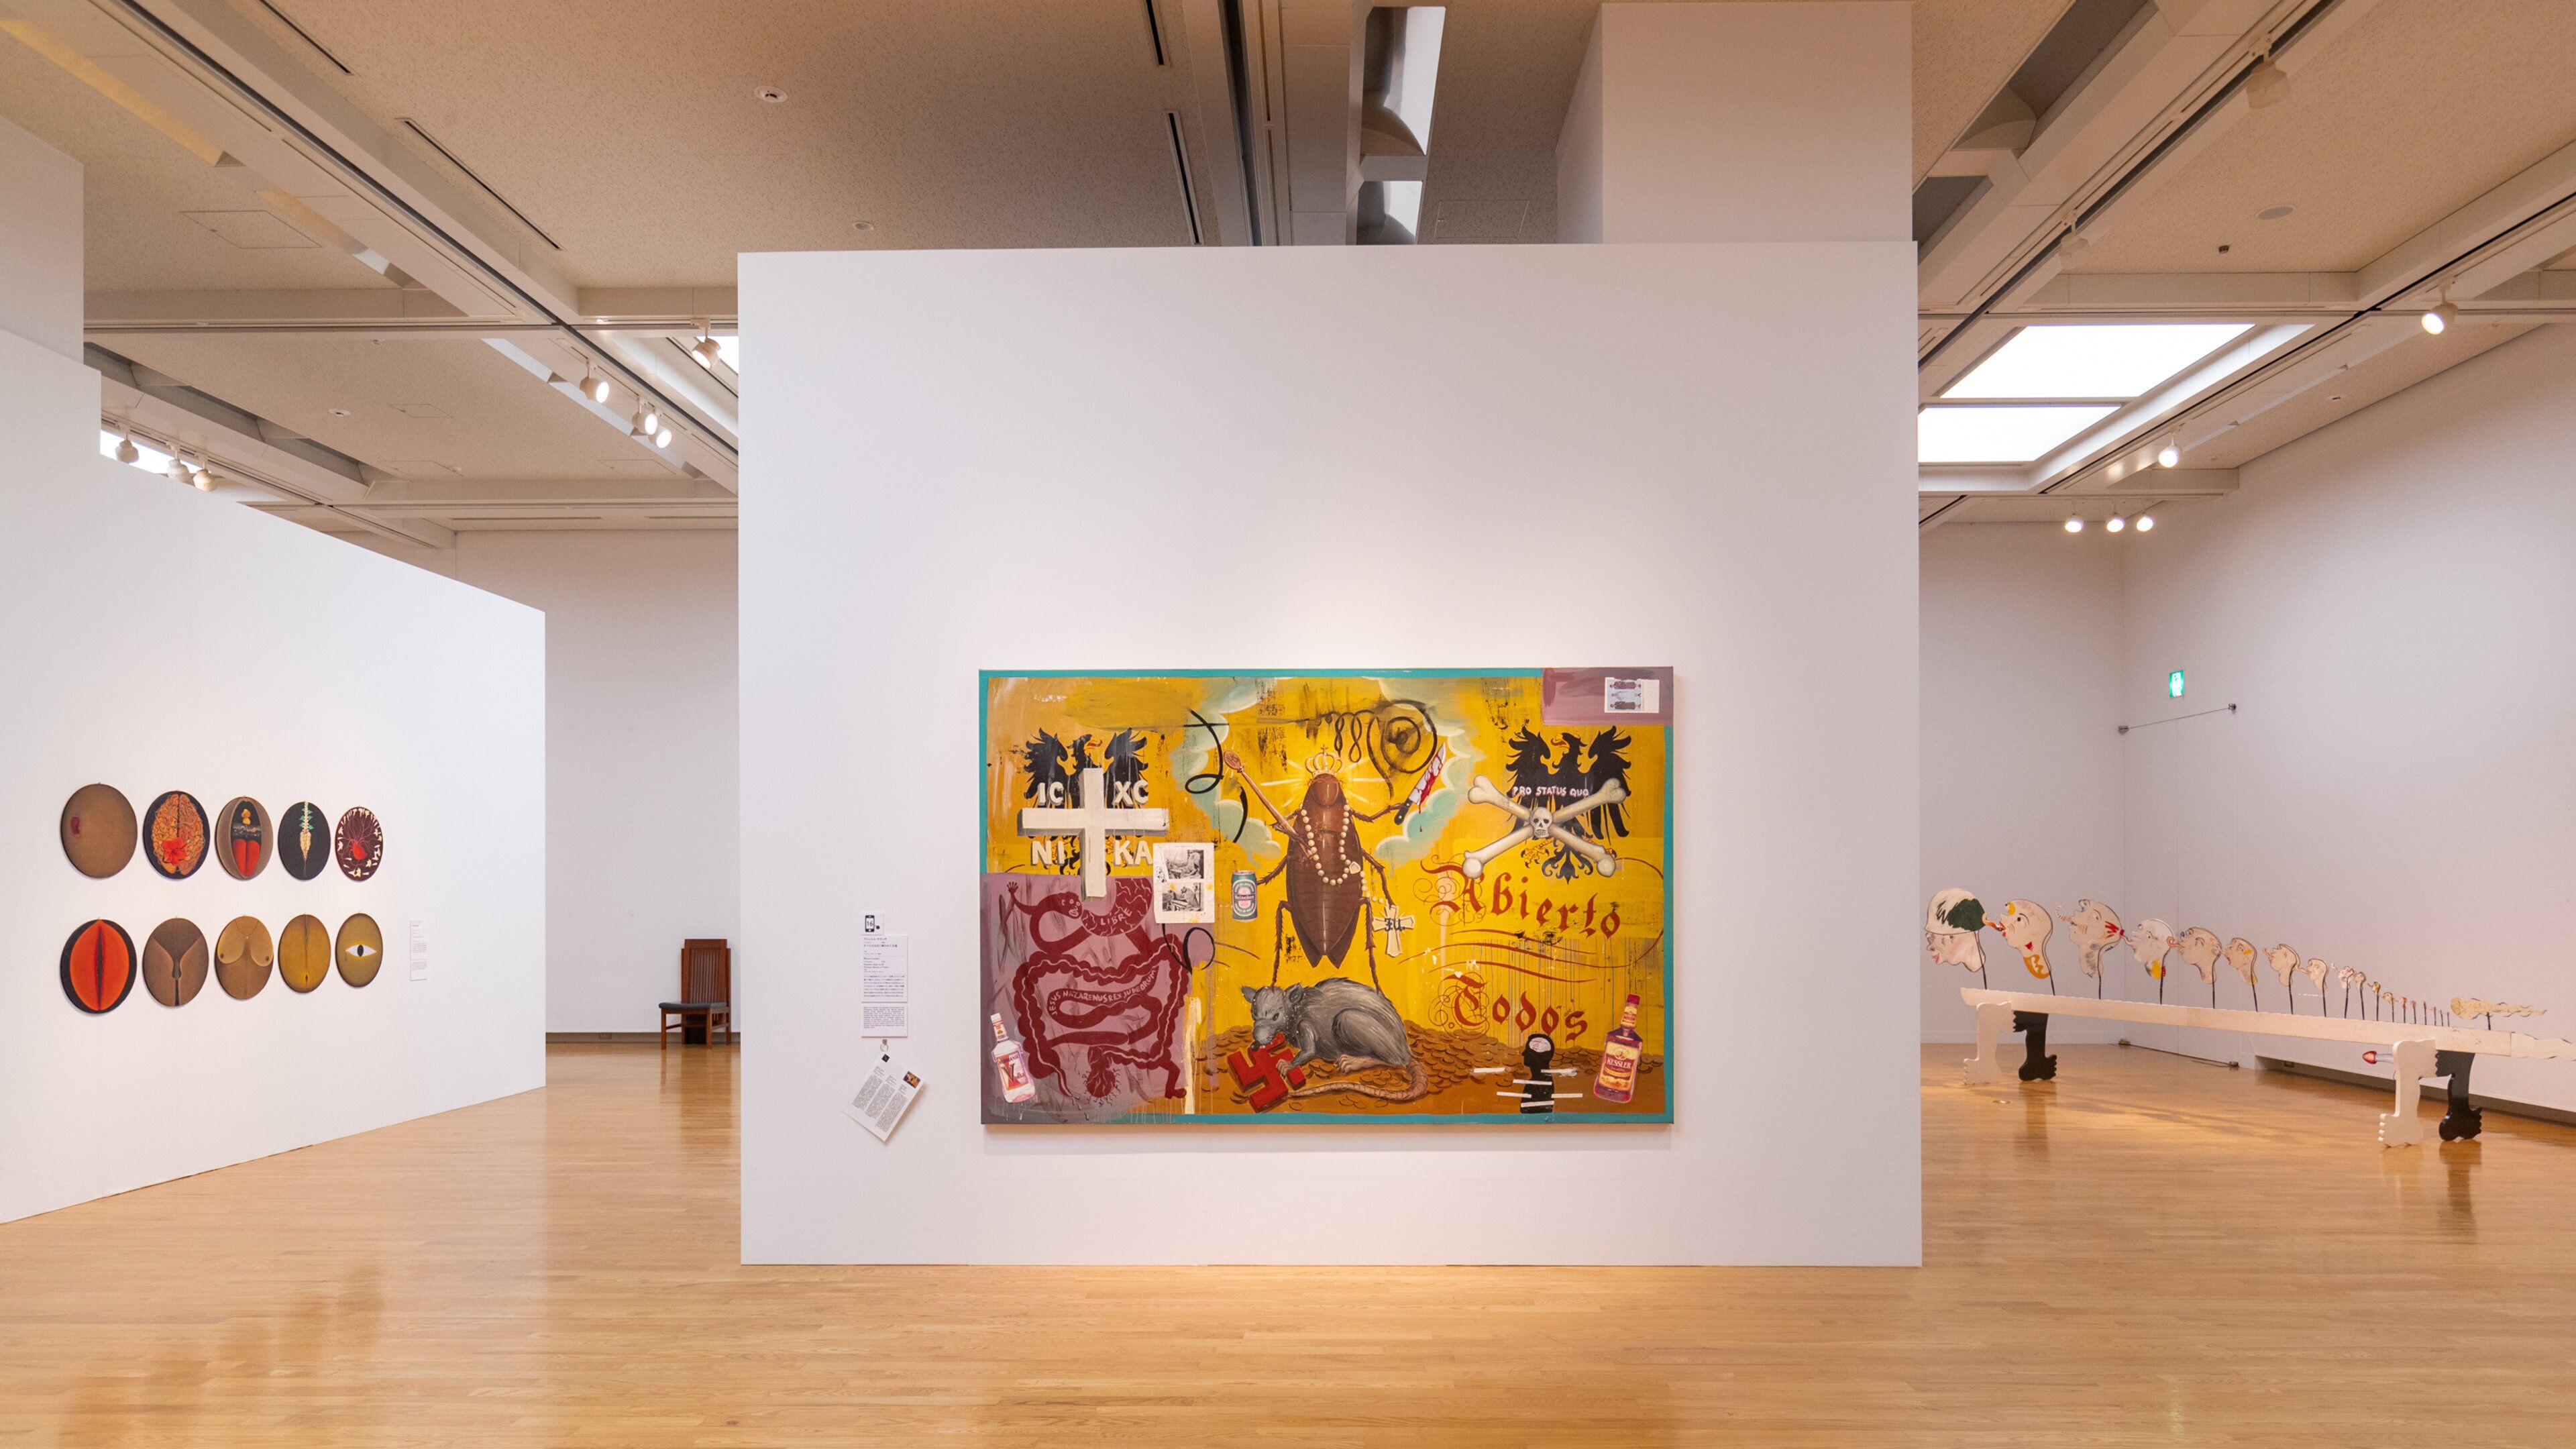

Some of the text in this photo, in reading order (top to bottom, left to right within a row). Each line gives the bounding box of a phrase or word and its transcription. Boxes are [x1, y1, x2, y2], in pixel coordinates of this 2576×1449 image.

[1038, 780, 1149, 806] IC XC
[1512, 786, 1589, 797] PRO STATUS QUO
[1419, 860, 1621, 939] Abierto
[1100, 908, 1132, 926] LIBRE
[1063, 990, 1108, 1003] NAZARENUS
[1108, 993, 1122, 1003] REX
[1442, 973, 1589, 1042] Todos
[1607, 1058, 1632, 1069] KESSLER
